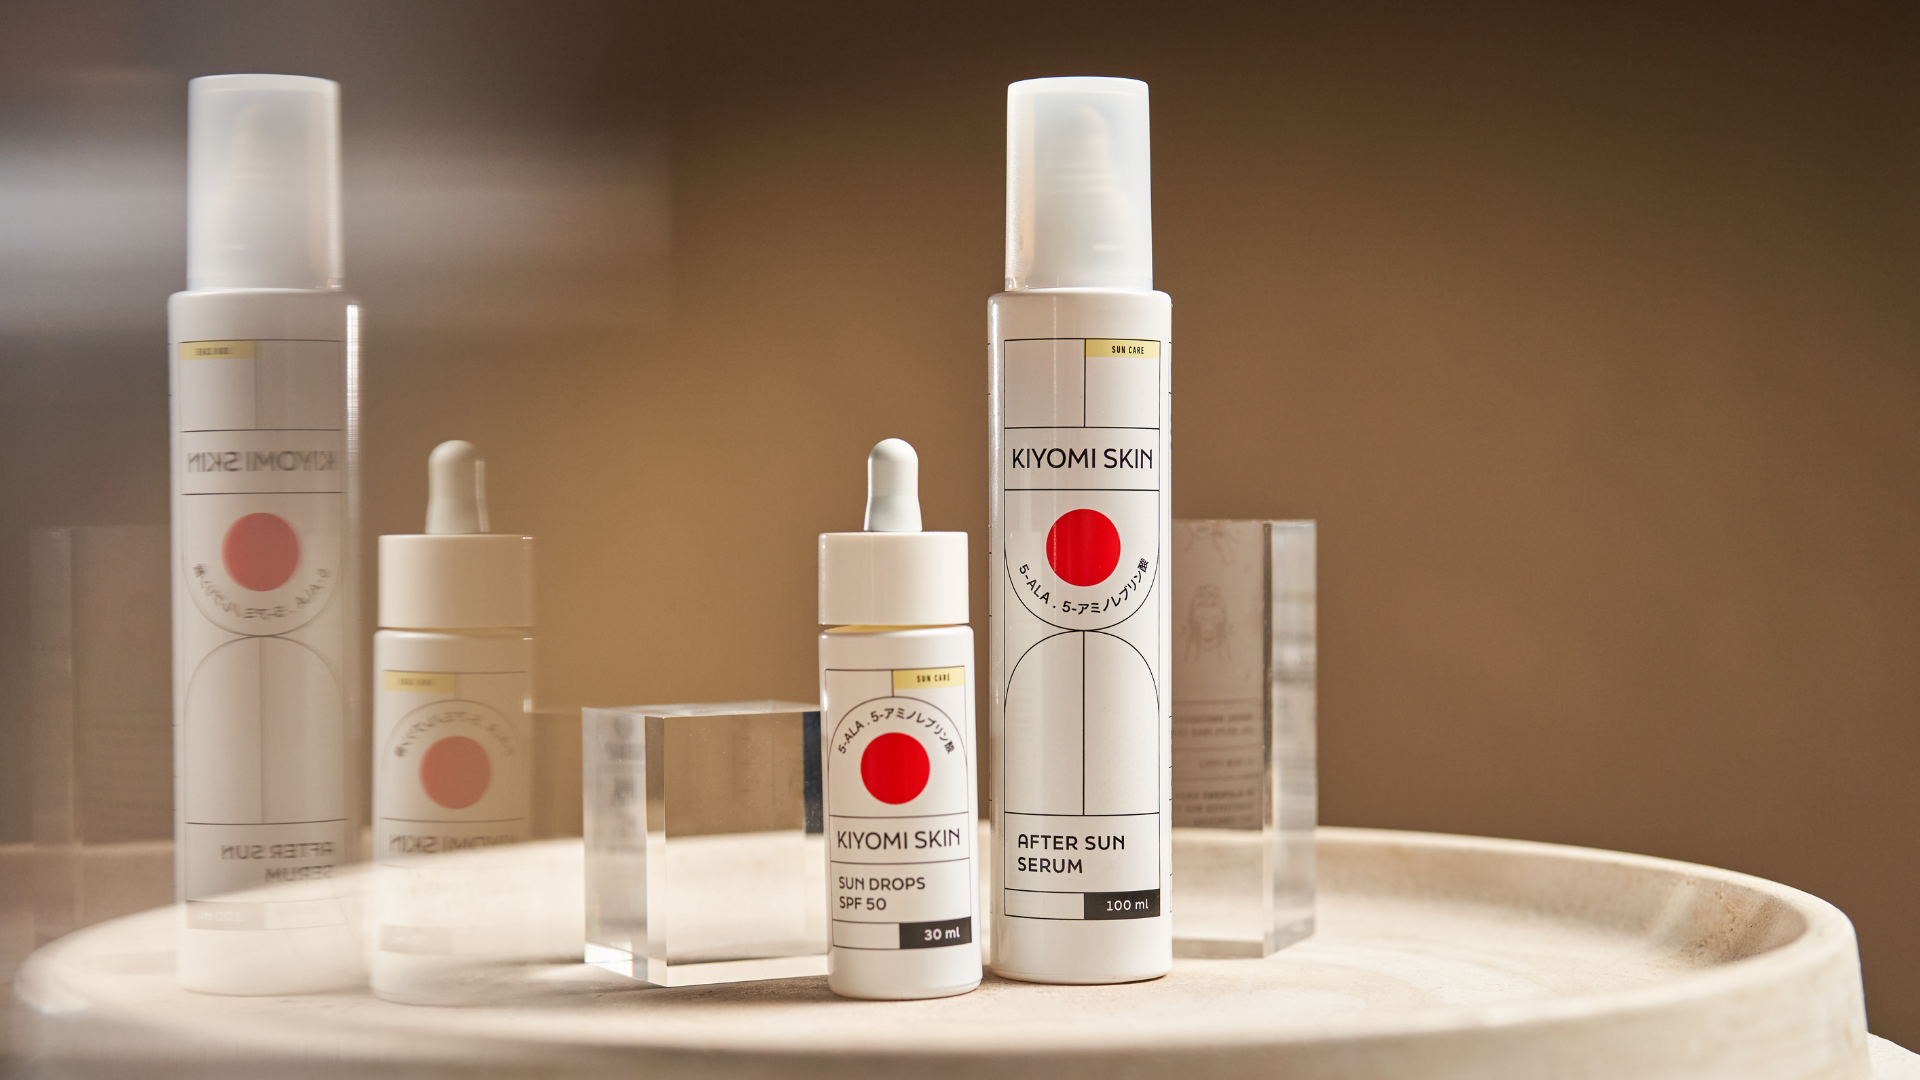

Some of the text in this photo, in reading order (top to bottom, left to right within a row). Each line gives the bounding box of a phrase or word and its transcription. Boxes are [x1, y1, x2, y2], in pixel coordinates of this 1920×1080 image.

[1111, 345, 1144, 355] SUN CARE
[1012, 448, 1153, 470] KIYOMI SKIN
[1019, 563, 1050, 605] 5-ALA
[916, 673, 951, 683] SUN CARE
[838, 719, 865, 755] 5-ALA
[837, 828, 961, 850] KIYOMI SKIN
[1018, 833, 1126, 851] AFTER SUN
[1018, 856, 1083, 874] SERUM
[838, 876, 926, 891] SUN DROPS
[839, 896, 887, 911] SPF 50
[1106, 899, 1149, 911] 100 ml
[924, 926, 961, 942] 30 ml
